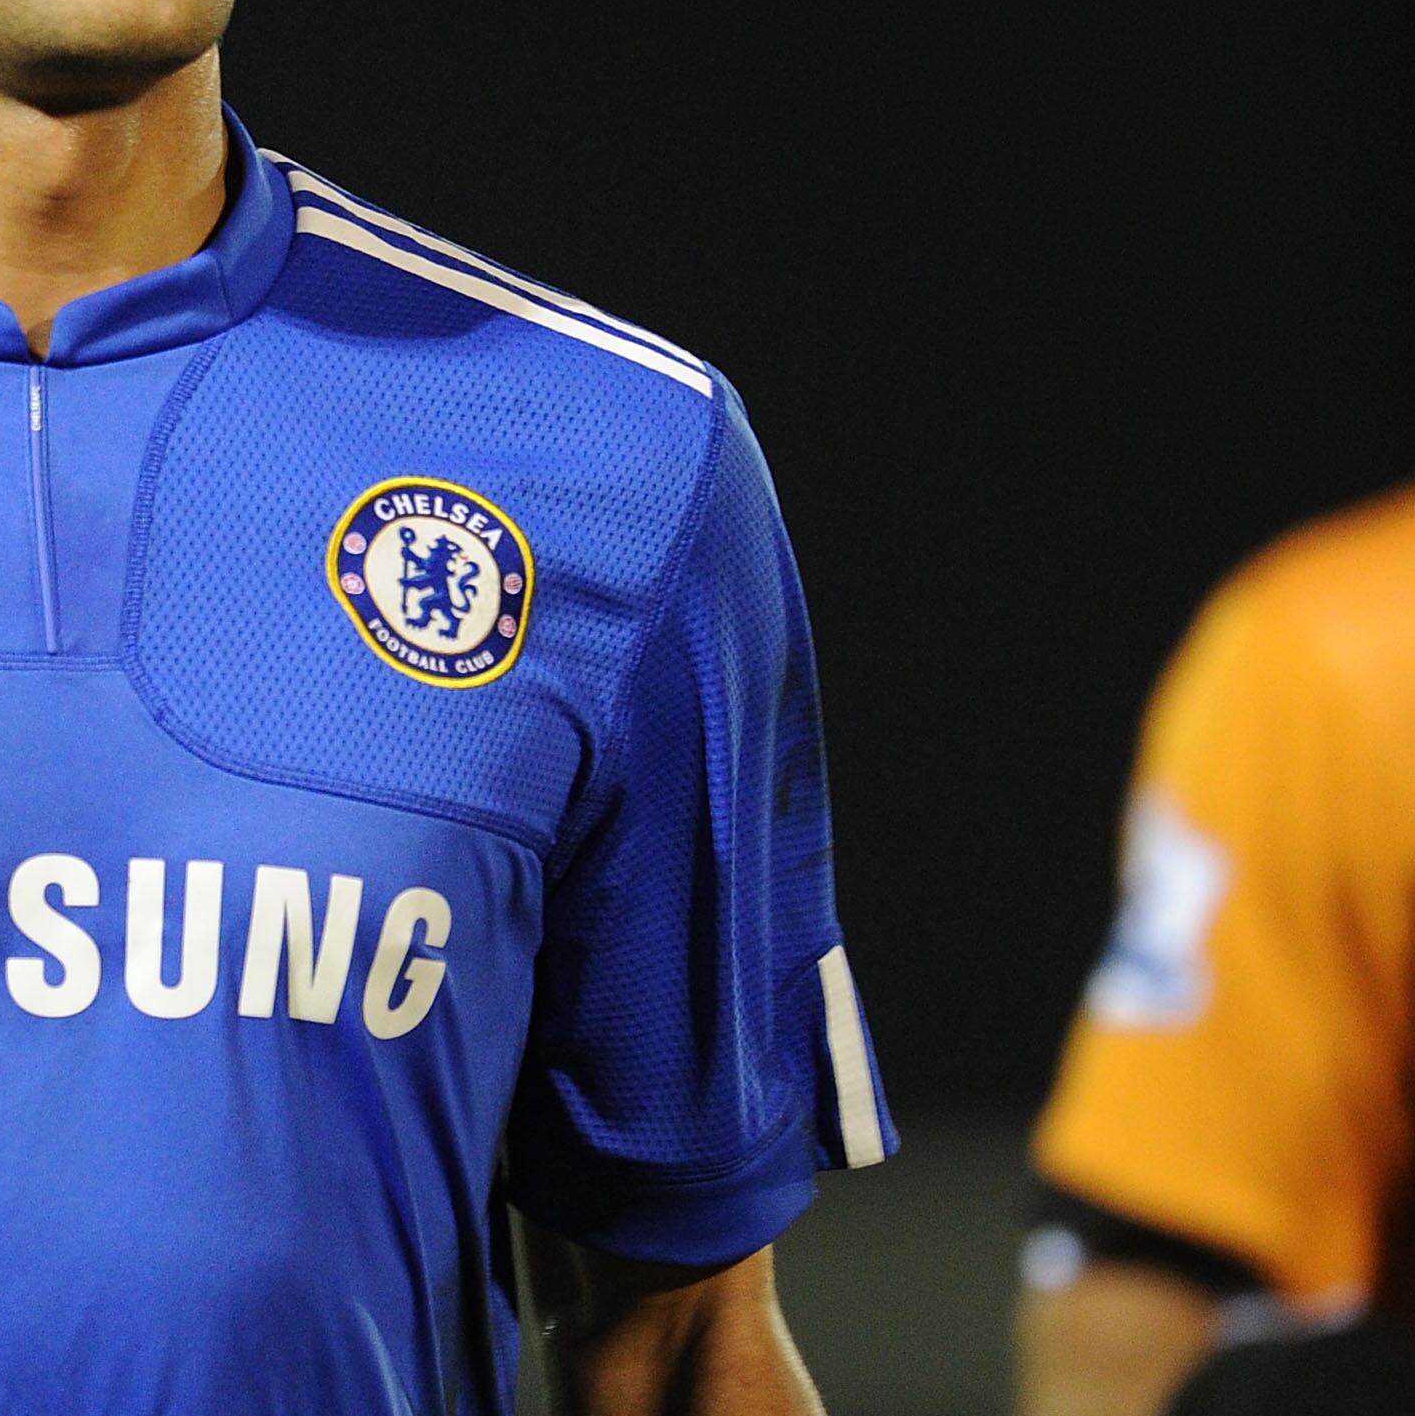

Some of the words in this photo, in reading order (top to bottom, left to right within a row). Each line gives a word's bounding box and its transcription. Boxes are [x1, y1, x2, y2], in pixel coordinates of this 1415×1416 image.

[373, 492, 503, 551] CHELSEA
[368, 618, 449, 673] FOOTBALL
[454, 649, 495, 674] CLUB
